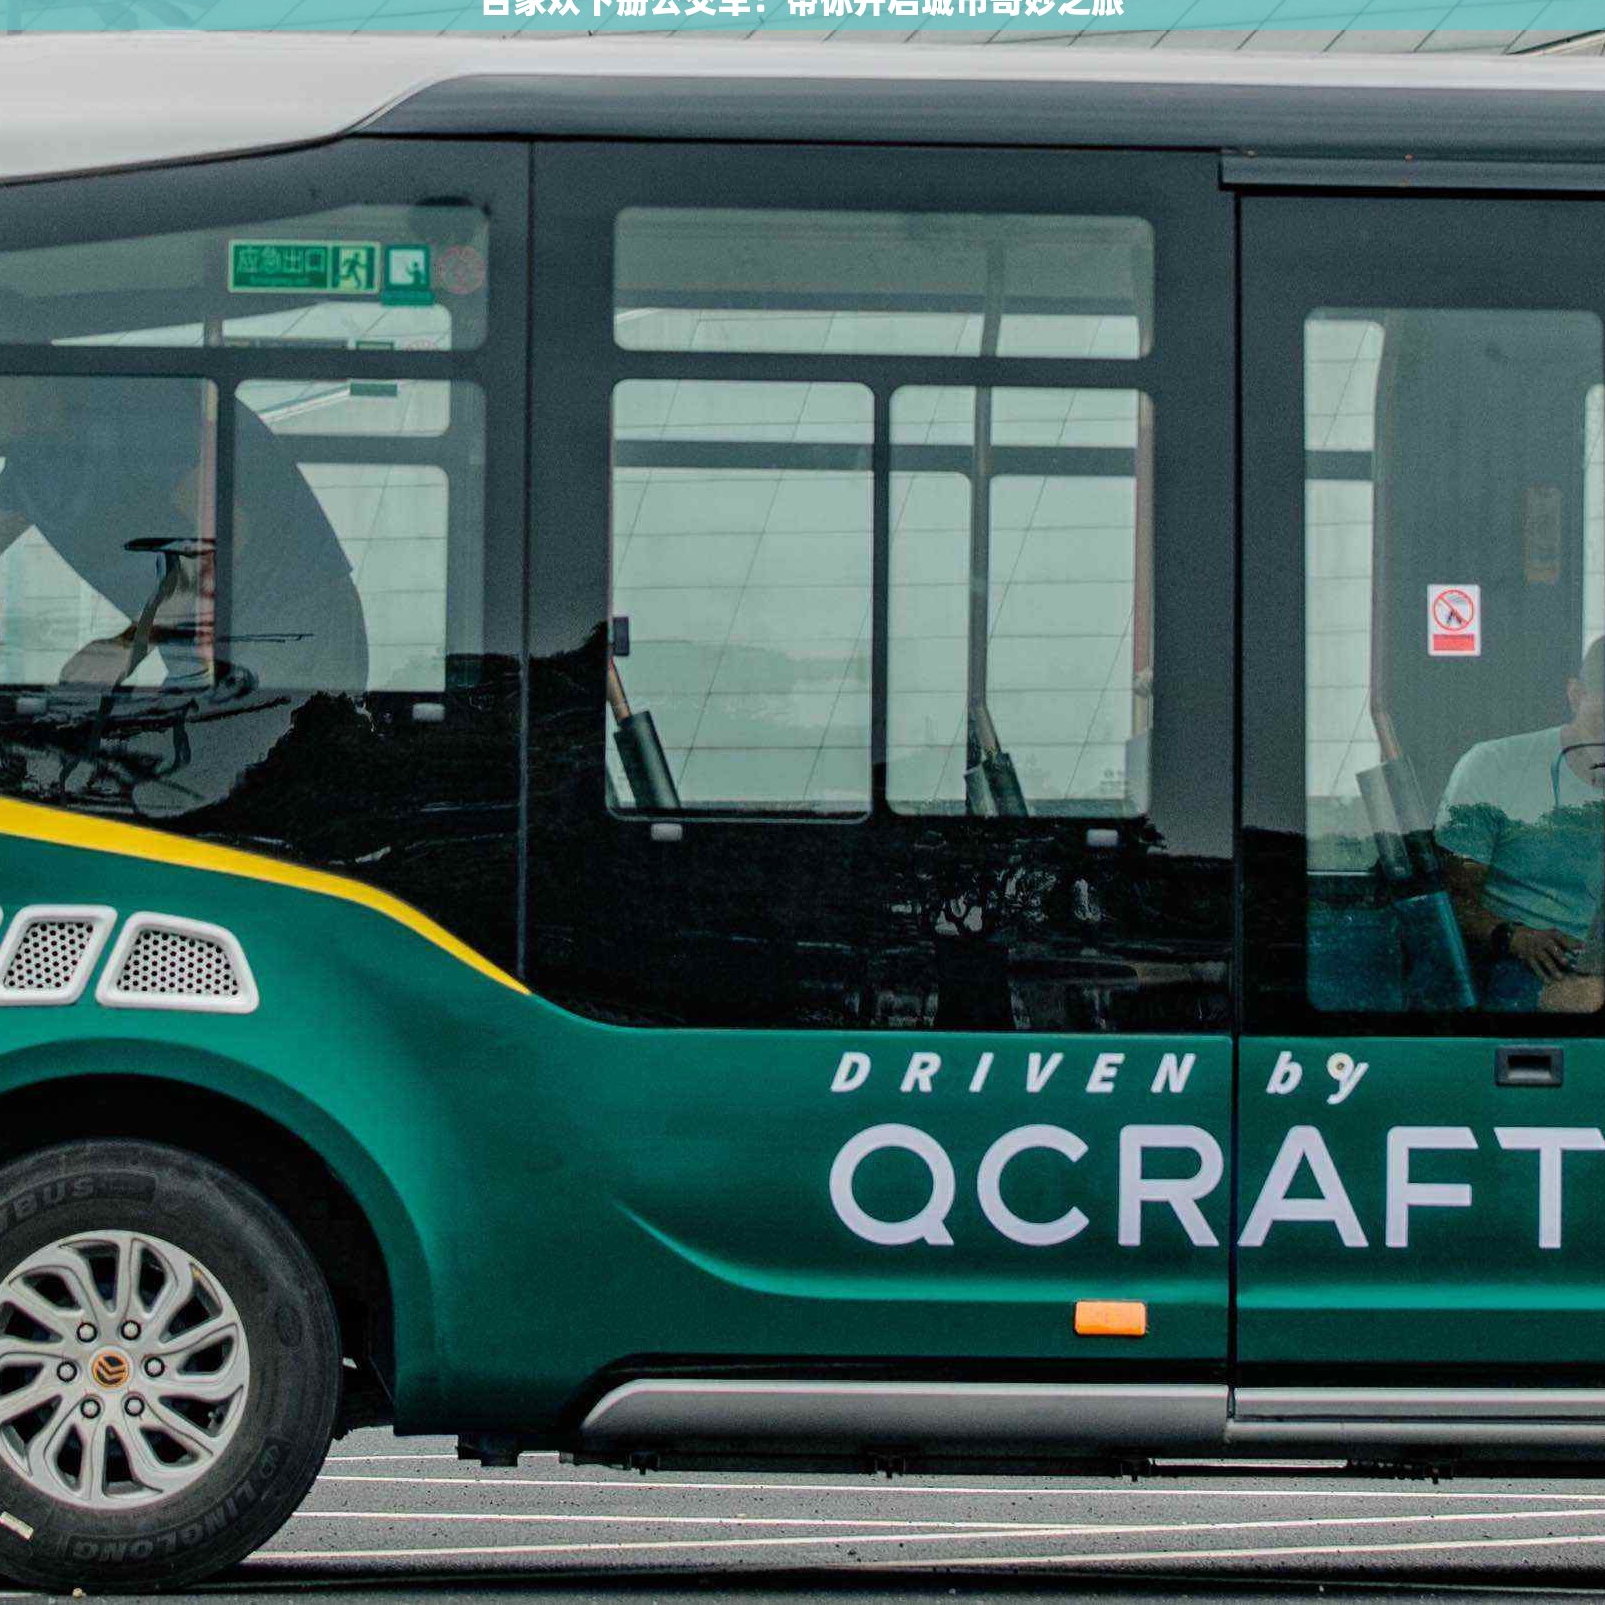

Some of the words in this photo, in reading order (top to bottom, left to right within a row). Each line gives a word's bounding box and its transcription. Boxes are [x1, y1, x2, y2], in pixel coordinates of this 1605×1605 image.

[238, 247, 325, 274] 应急出口
[830, 1051, 1197, 1093] DRIVEN
[1266, 1050, 1370, 1105] by
